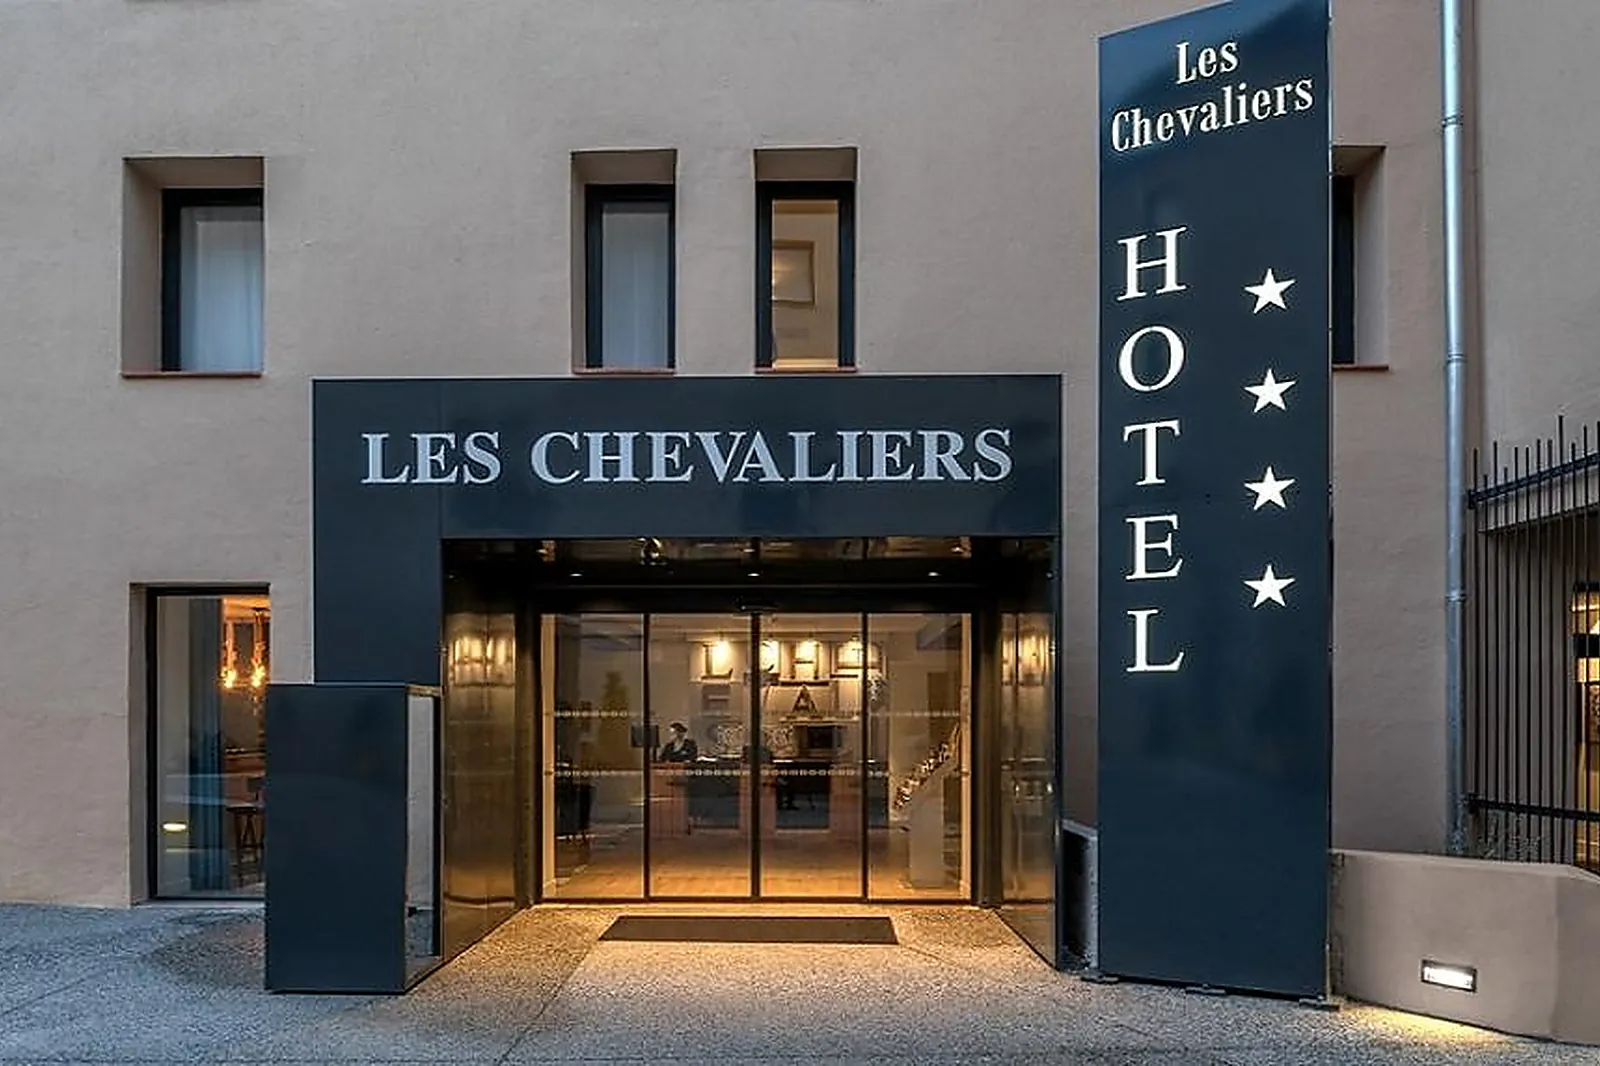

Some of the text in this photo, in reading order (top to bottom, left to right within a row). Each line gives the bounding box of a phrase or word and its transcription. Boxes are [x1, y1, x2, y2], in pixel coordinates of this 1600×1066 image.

[1175, 41, 1238, 84] Les
[1111, 79, 1313, 153] Chevaliers
[360, 428, 1012, 485] LES CHEVALIERS
[1116, 226, 1187, 674] HOTEL
